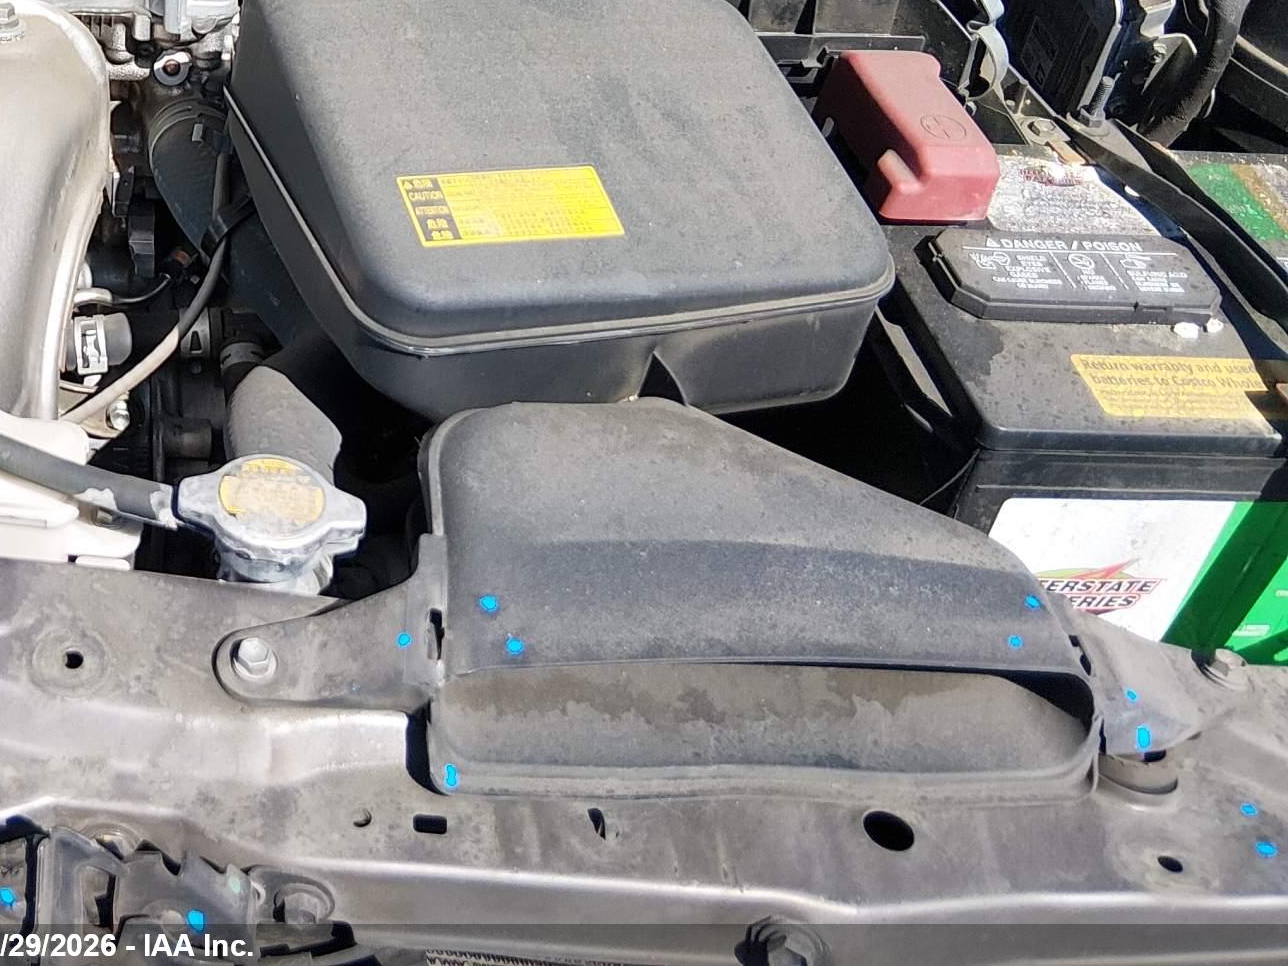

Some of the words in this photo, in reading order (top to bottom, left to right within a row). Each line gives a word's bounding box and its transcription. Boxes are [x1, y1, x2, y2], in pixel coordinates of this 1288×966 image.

[409, 191, 444, 202] CAUTION
[999, 238, 1069, 251] DANGER
[1071, 240, 1078, 251] /
[1082, 241, 1143, 252] POISON
[1081, 359, 1130, 372] Return
[1198, 362, 1222, 374] and
[1091, 375, 1151, 386] batteries
[1154, 376, 1170, 386] to
[1171, 376, 1216, 388] Costco
[1220, 378, 1265, 389] Whole
[1040, 580, 1154, 593] ERSTATE
[1070, 595, 1136, 608] ERIES
